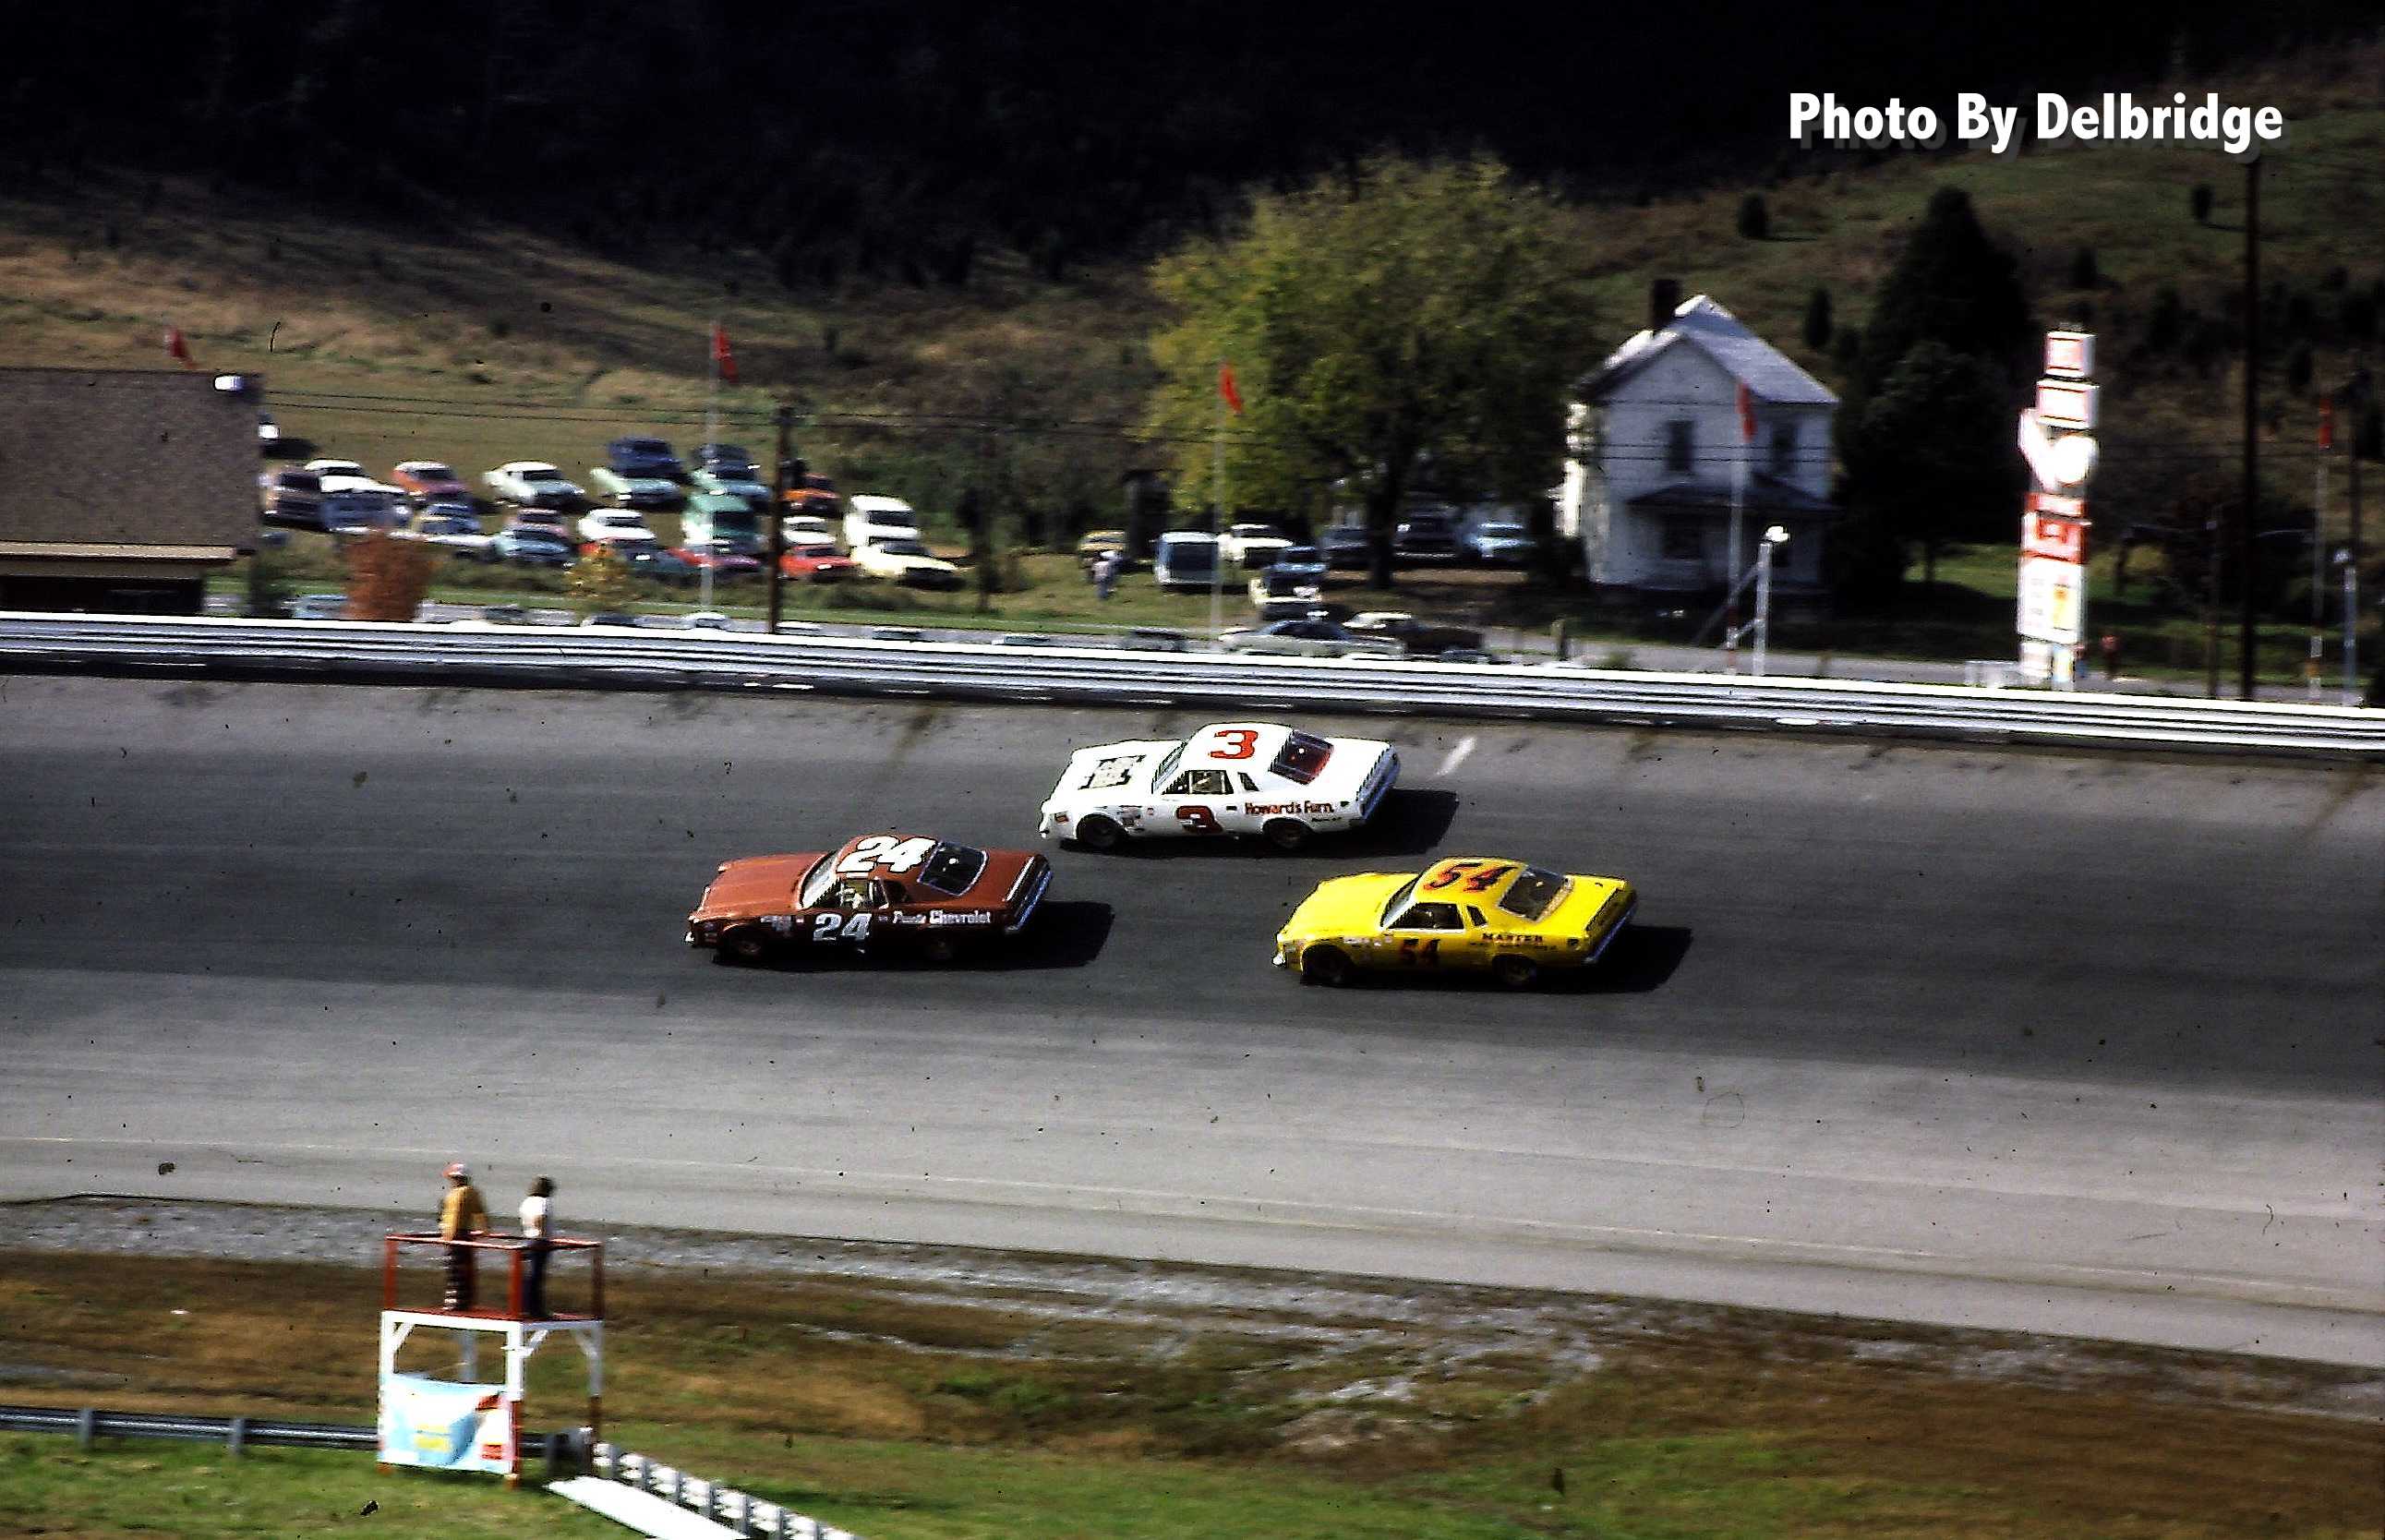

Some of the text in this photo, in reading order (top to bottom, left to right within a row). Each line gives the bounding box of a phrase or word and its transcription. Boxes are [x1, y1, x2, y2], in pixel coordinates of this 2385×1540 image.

[1208, 729, 1259, 759] 3
[1175, 805, 1223, 833] 3
[836, 835, 938, 873] 24
[1423, 862, 1519, 894] 54
[813, 912, 873, 941] 24
